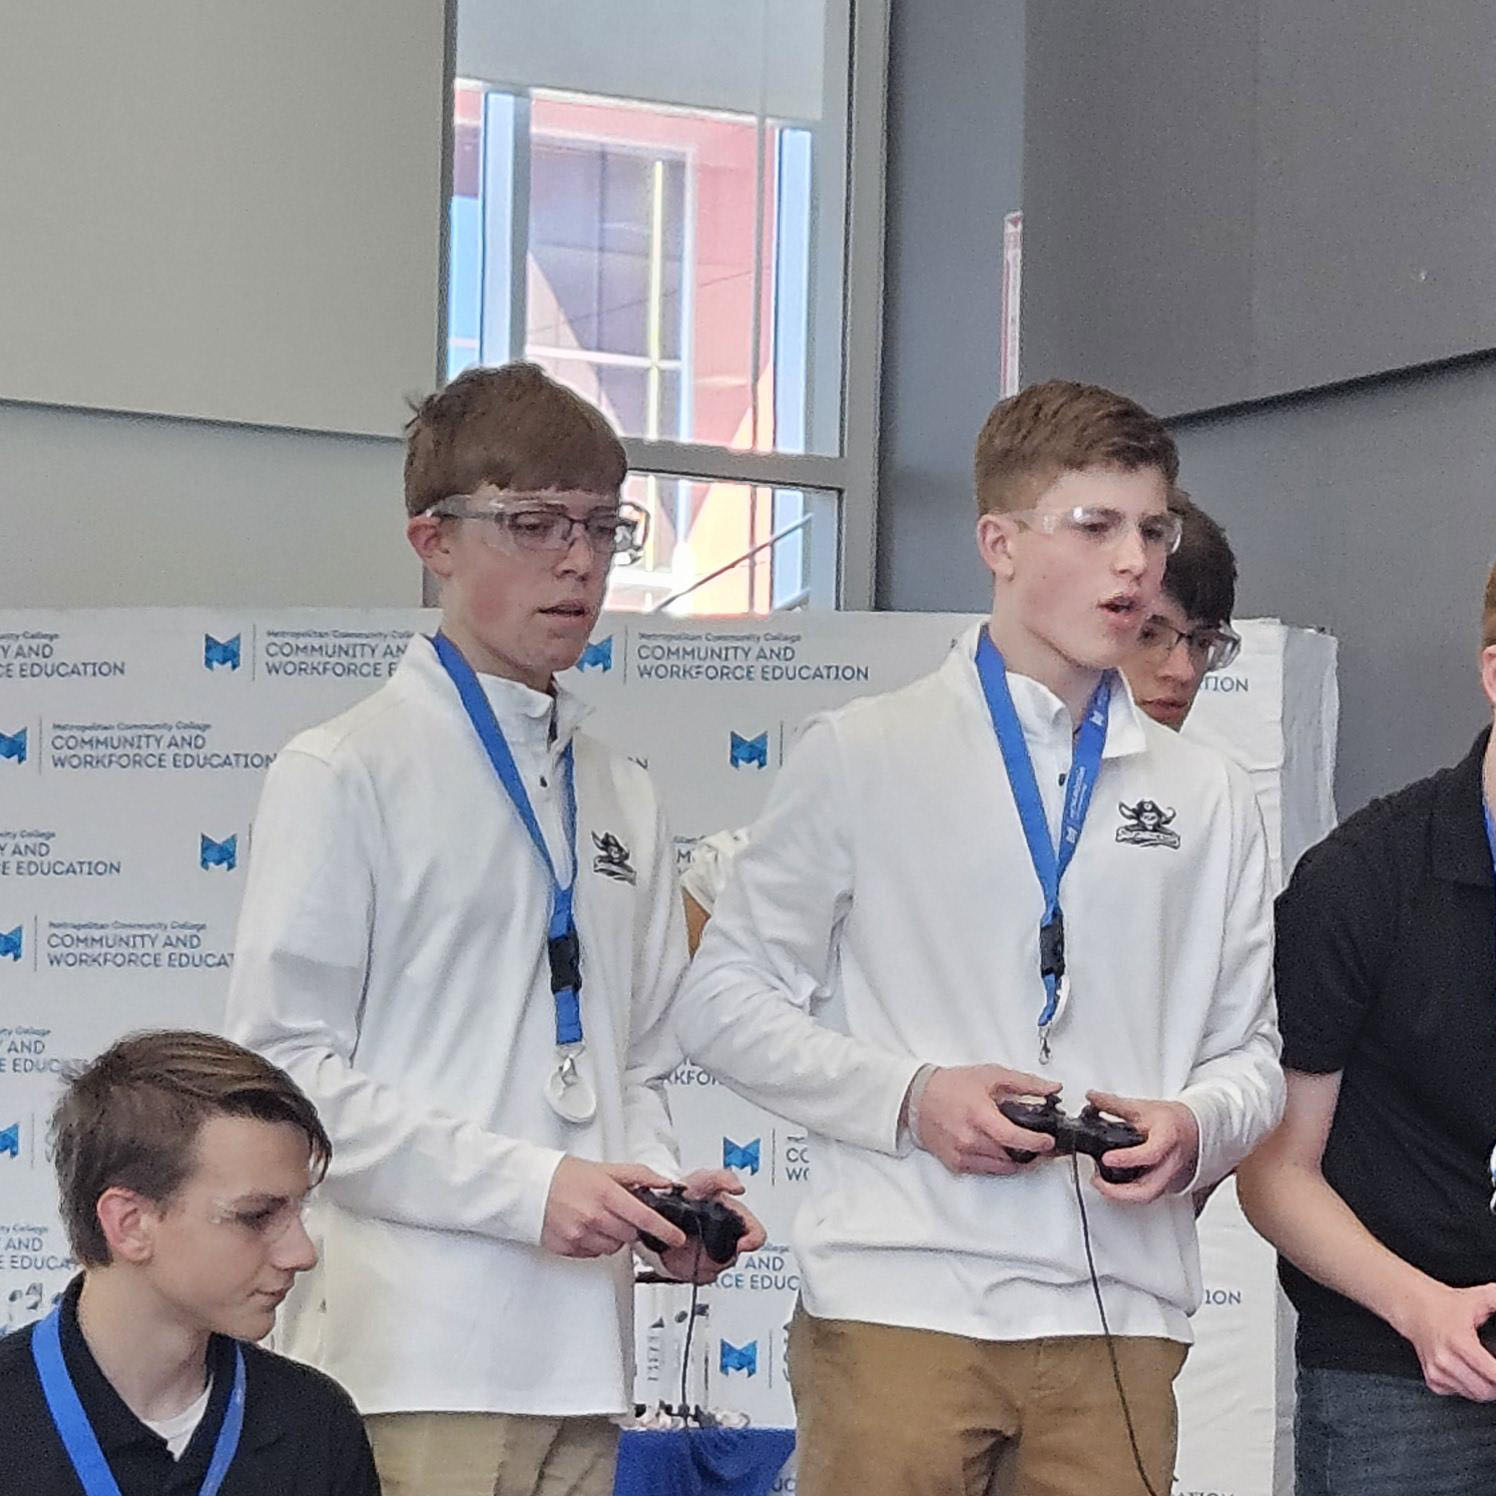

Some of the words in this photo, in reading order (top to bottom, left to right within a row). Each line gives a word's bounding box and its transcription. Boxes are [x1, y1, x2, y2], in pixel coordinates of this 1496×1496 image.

[14, 643, 54, 659] AND
[265, 642, 378, 658] COMMUNITY
[383, 644, 408, 658] AN
[637, 645, 751, 661] COMMUNITY
[755, 646, 796, 661] AND
[19, 661, 125, 678] EDUCATION
[265, 661, 382, 677] WORKFORCE
[637, 664, 754, 681] WORKFORCE
[761, 664, 870, 681] EDUCATION
[51, 735, 162, 750] COMMUNITY
[167, 735, 206, 750] AND
[52, 753, 166, 769] WORKFORCE
[172, 753, 278, 769] EDUCATION
[12, 842, 51, 857] AND
[16, 860, 121, 876] EDUCATION
[47, 933, 159, 949] COMMUNITY
[162, 934, 202, 949] AND
[48, 952, 162, 968] WORKFORCE
[7, 1040, 46, 1055] AND
[4, 1237, 44, 1252] AND
[744, 1256, 785, 1272] AND
